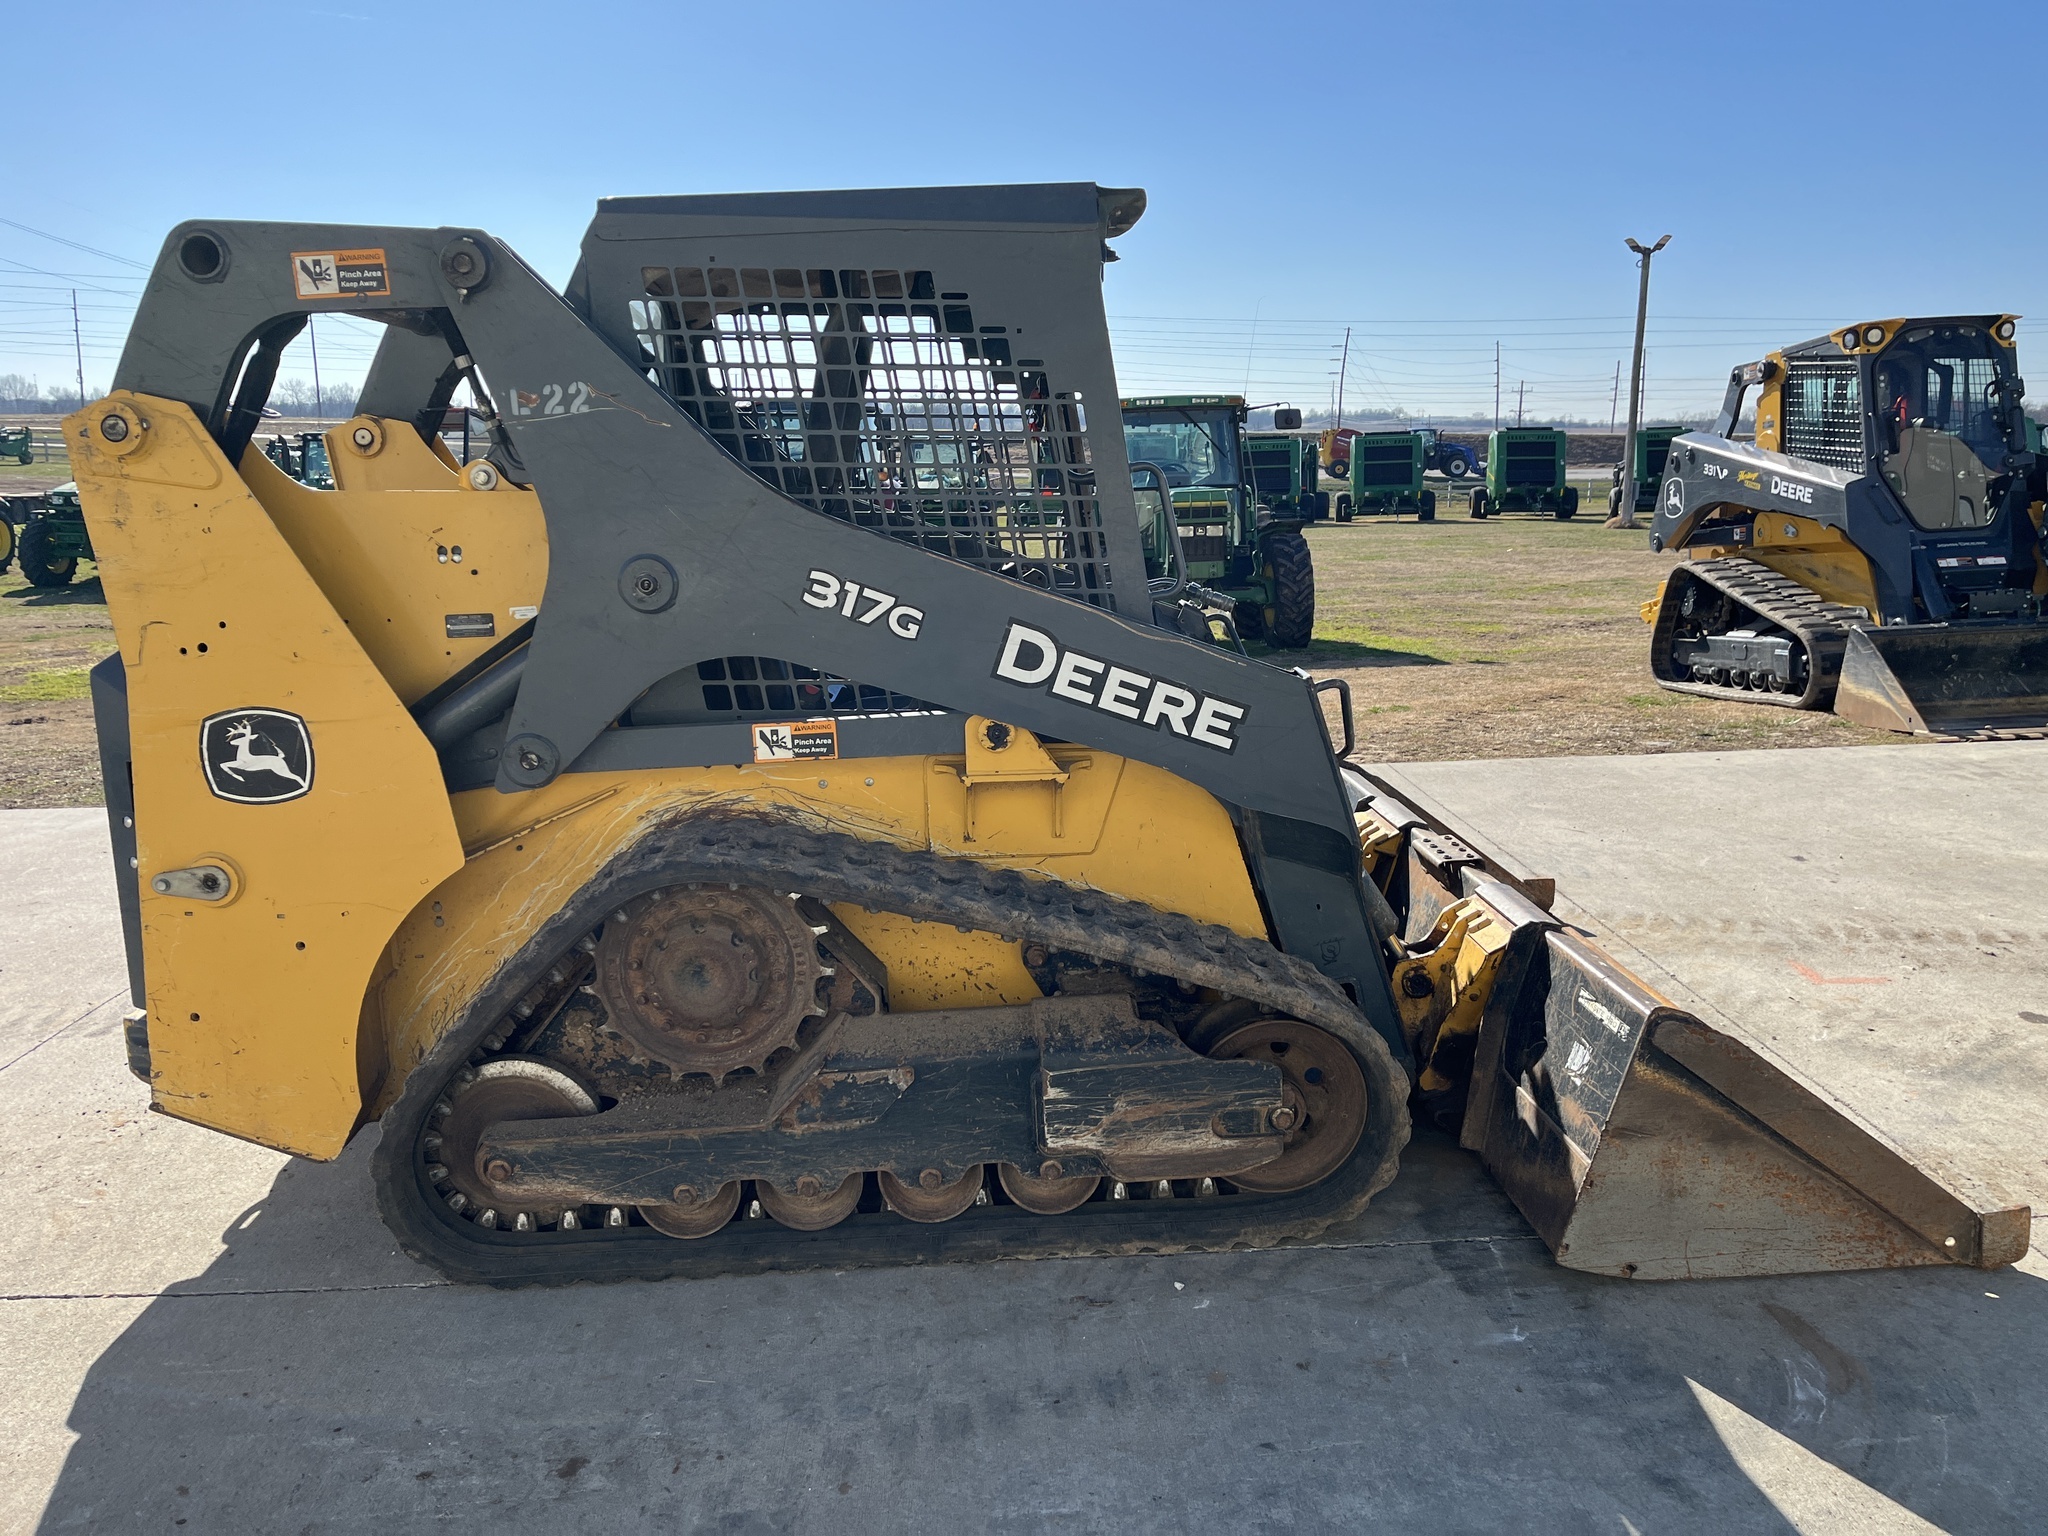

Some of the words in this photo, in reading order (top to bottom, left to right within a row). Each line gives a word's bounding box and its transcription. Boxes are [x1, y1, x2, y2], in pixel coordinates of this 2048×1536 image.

[345, 253, 381, 261] WARNING
[340, 271, 362, 279] Pinch
[363, 270, 382, 278] Area
[1771, 475, 1814, 504] DEERE
[802, 570, 925, 639] 317G
[996, 622, 1246, 751] DEERE
[794, 738, 815, 746] Pinch
[815, 737, 832, 745] Area
